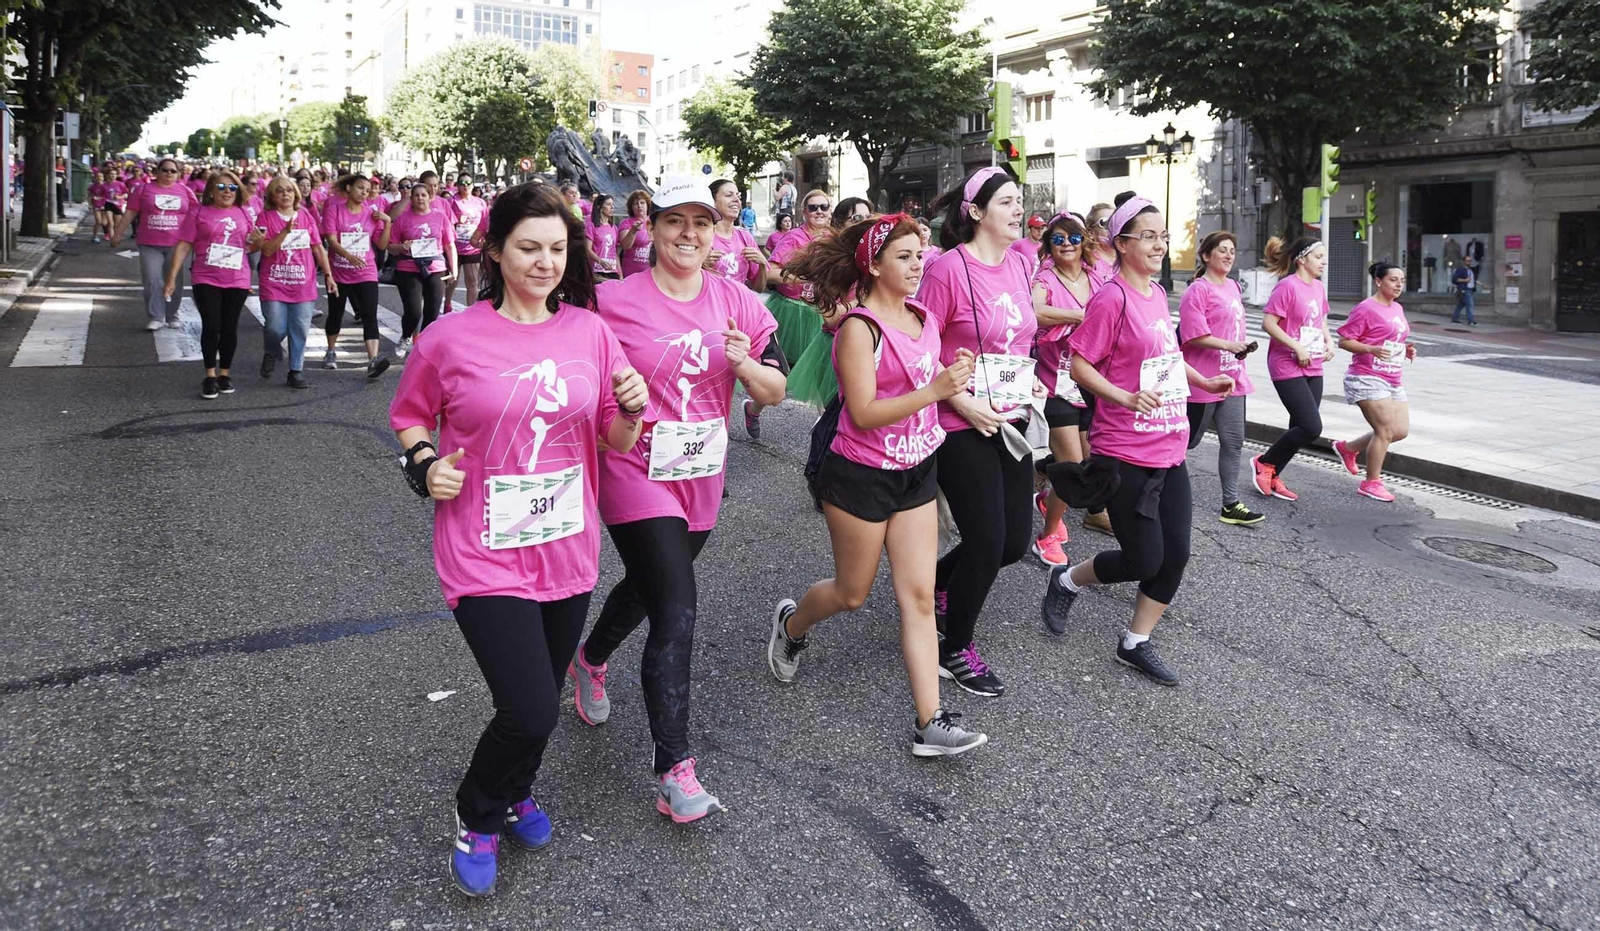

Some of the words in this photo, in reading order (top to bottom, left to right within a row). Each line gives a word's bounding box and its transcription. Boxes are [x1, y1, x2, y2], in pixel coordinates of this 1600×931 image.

[269, 270, 306, 279] FEMENINA
[270, 264, 306, 272] CARRERA
[999, 370, 1016, 383] 968
[683, 441, 704, 456] 332
[530, 495, 555, 515] 331
